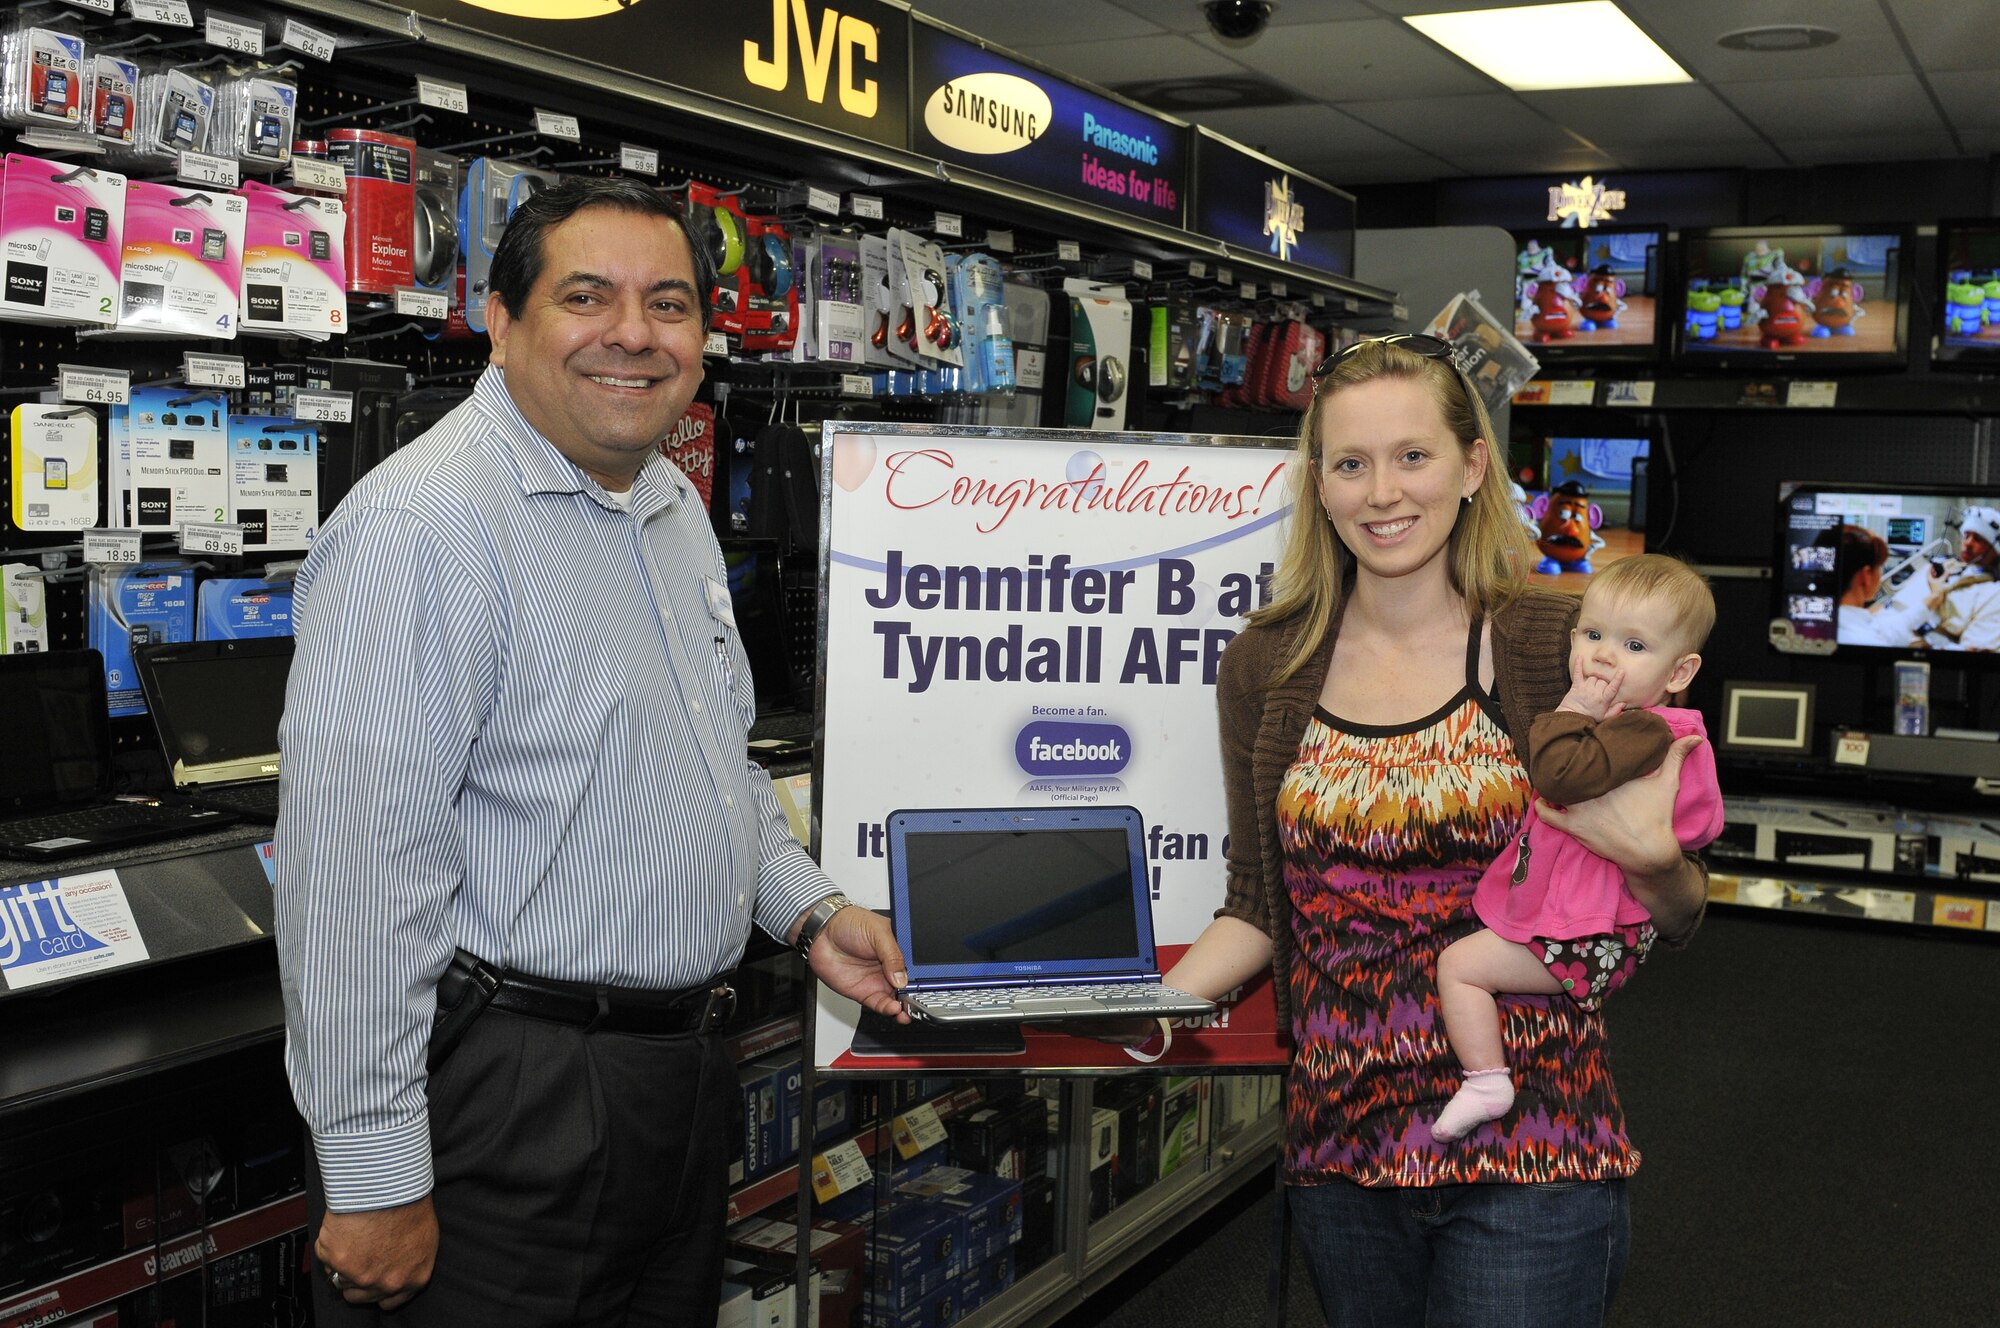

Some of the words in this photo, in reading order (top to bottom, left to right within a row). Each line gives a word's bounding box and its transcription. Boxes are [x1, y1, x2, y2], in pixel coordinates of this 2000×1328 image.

[155, 10, 188, 24] 54.95
[226, 36, 257, 53] 39.95
[302, 40, 330, 59] 64.95
[743, 0, 878, 118] JVC
[438, 97, 464, 111] 74.95
[943, 83, 1037, 142] SAMSUNG
[553, 125, 577, 136] 54.95
[1083, 112, 1158, 166] Panasonic
[635, 160, 654, 172] 59.95
[203, 170, 234, 186] 17.95
[313, 173, 342, 188] 32.95
[1082, 153, 1126, 193] ideas
[1128, 170, 1151, 202] for
[1153, 177, 1176, 211] life
[372, 234, 393, 243] Microsoft
[8, 241, 37, 252] microSD
[372, 242, 407, 257] Explorer
[125, 262, 164, 274] microSDHC
[372, 256, 392, 267] Mouse
[246, 266, 280, 274] microSDHC
[10, 276, 43, 287] SONY
[99, 297, 112, 313] 2
[126, 295, 159, 305] SONY
[250, 297, 279, 306] SONY
[330, 309, 341, 323] 8
[416, 305, 444, 318] 29.95
[216, 314, 231, 329] 4
[830, 342, 840, 354] 10
[274, 371, 295, 381] iHome
[306, 367, 328, 376] iHome
[211, 373, 241, 386] 17.95
[249, 374, 270, 385] iHome
[86, 389, 123, 403] 64.95
[316, 409, 346, 422] 29.95
[670, 447, 713, 478] itty
[141, 466, 164, 475] MEMORY
[165, 466, 180, 475] STICK
[180, 467, 192, 475] PRO
[261, 489, 274, 497] STICK
[275, 489, 287, 497] PRO
[884, 449, 1287, 534] Congratulations!
[140, 501, 168, 509] SONY
[70, 517, 91, 525] 16GB
[214, 508, 224, 522] 2
[305, 527, 315, 540] 4
[205, 540, 237, 553] 69.95
[106, 550, 136, 562] 18.95
[126, 582, 167, 590] DANE-ELEC
[864, 550, 1135, 616] Jennifer
[1156, 558, 1196, 616] B
[873, 620, 1101, 694] Tyndall
[110, 673, 119, 681] 10
[1032, 705, 1075, 716] Become
[1077, 708, 1084, 717] a
[1086, 705, 1108, 717] fan.
[1029, 736, 1121, 762] facebook
[260, 764, 279, 773] DELL
[1029, 785, 1054, 793] AAFES,
[1055, 785, 1071, 793] Your
[1072, 785, 1098, 794] Military
[1099, 785, 1121, 793] BX/PX
[1051, 793, 1073, 802] (Official
[1074, 794, 1099, 803] Page)
[1147, 825, 1209, 860] fan
[78, 882, 113, 894] occasion!
[39, 930, 87, 956] card
[72, 958, 87, 966] online
[93, 952, 115, 960] aafes.com
